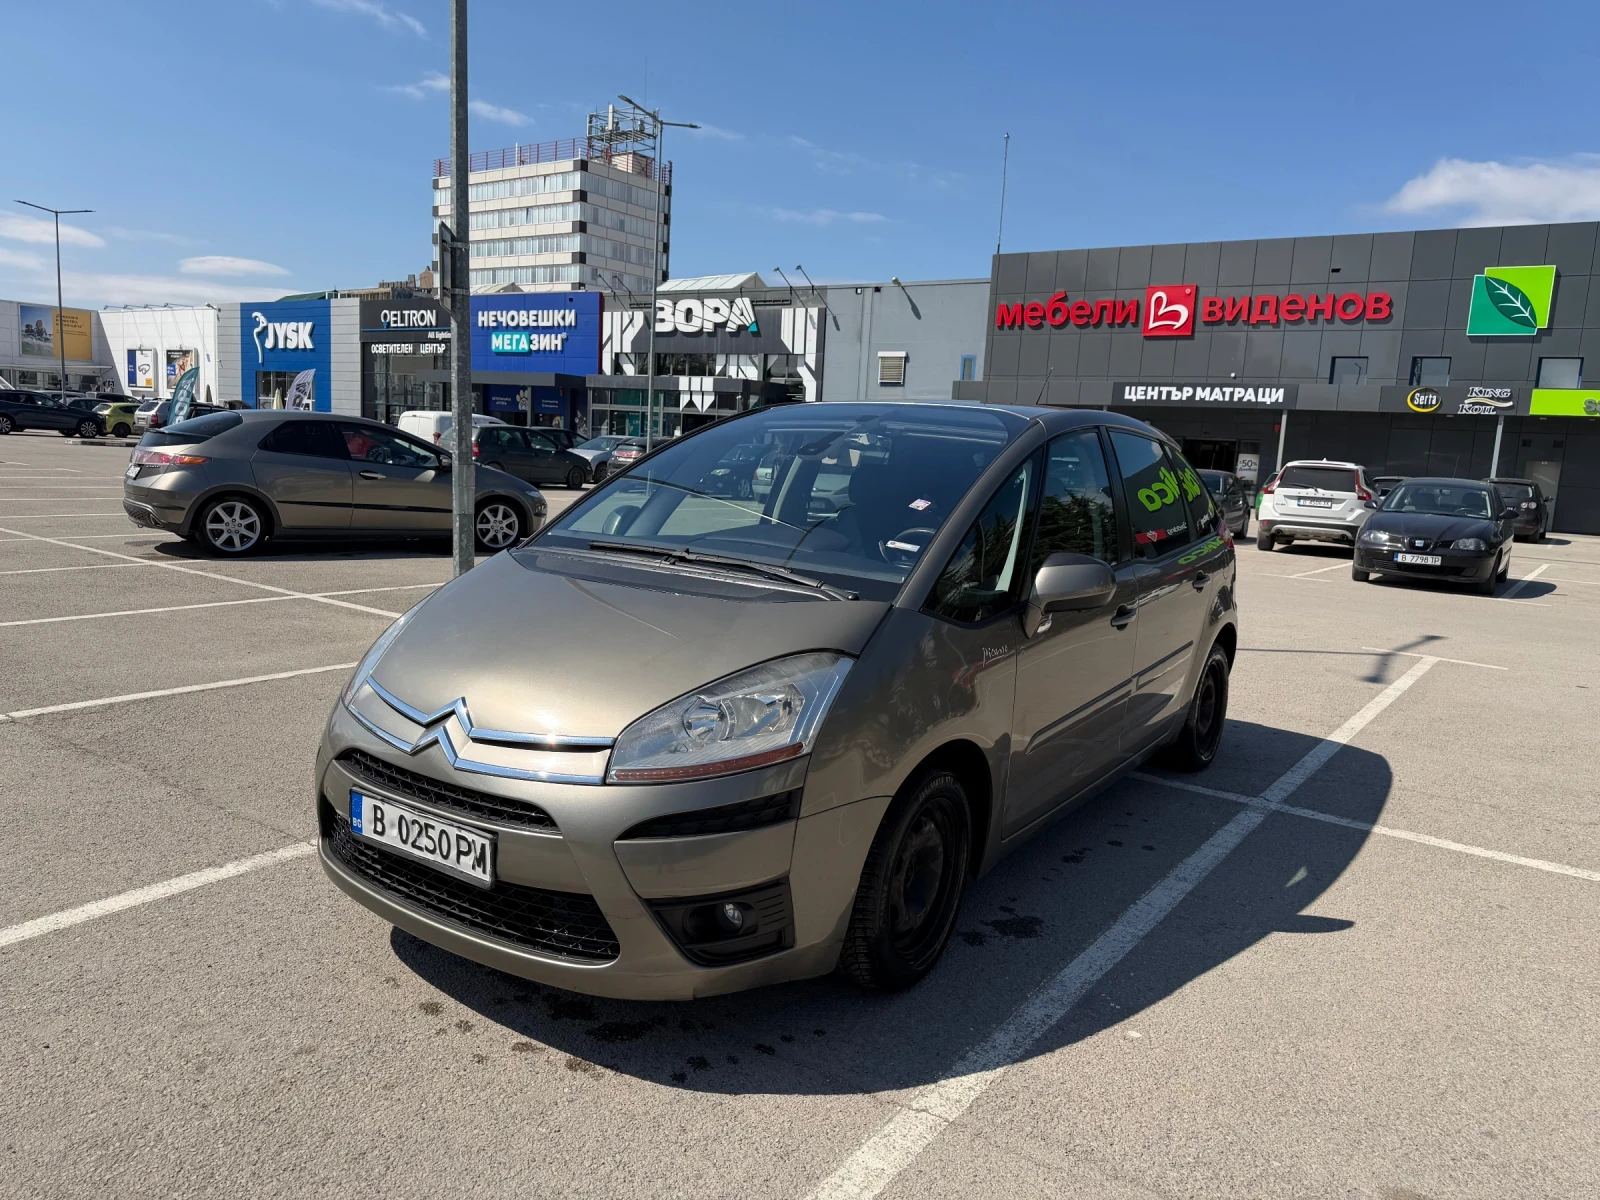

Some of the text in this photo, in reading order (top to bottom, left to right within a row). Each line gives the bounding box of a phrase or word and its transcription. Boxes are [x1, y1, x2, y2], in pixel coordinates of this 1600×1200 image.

[478, 309, 576, 327] НЕЧОВЕШКИ
[996, 291, 1391, 327] мебели виденов
[265, 322, 315, 349] JYSK
[371, 343, 446, 355] ОСВЕТИТЕЛЕН ЦЕНТЪР
[1124, 386, 1285, 404] ЦЕНТЪР МАТРАЦИ
[1413, 392, 1437, 406] Serta
[352, 817, 362, 828] BG
[373, 804, 487, 875] B 0250 PM
